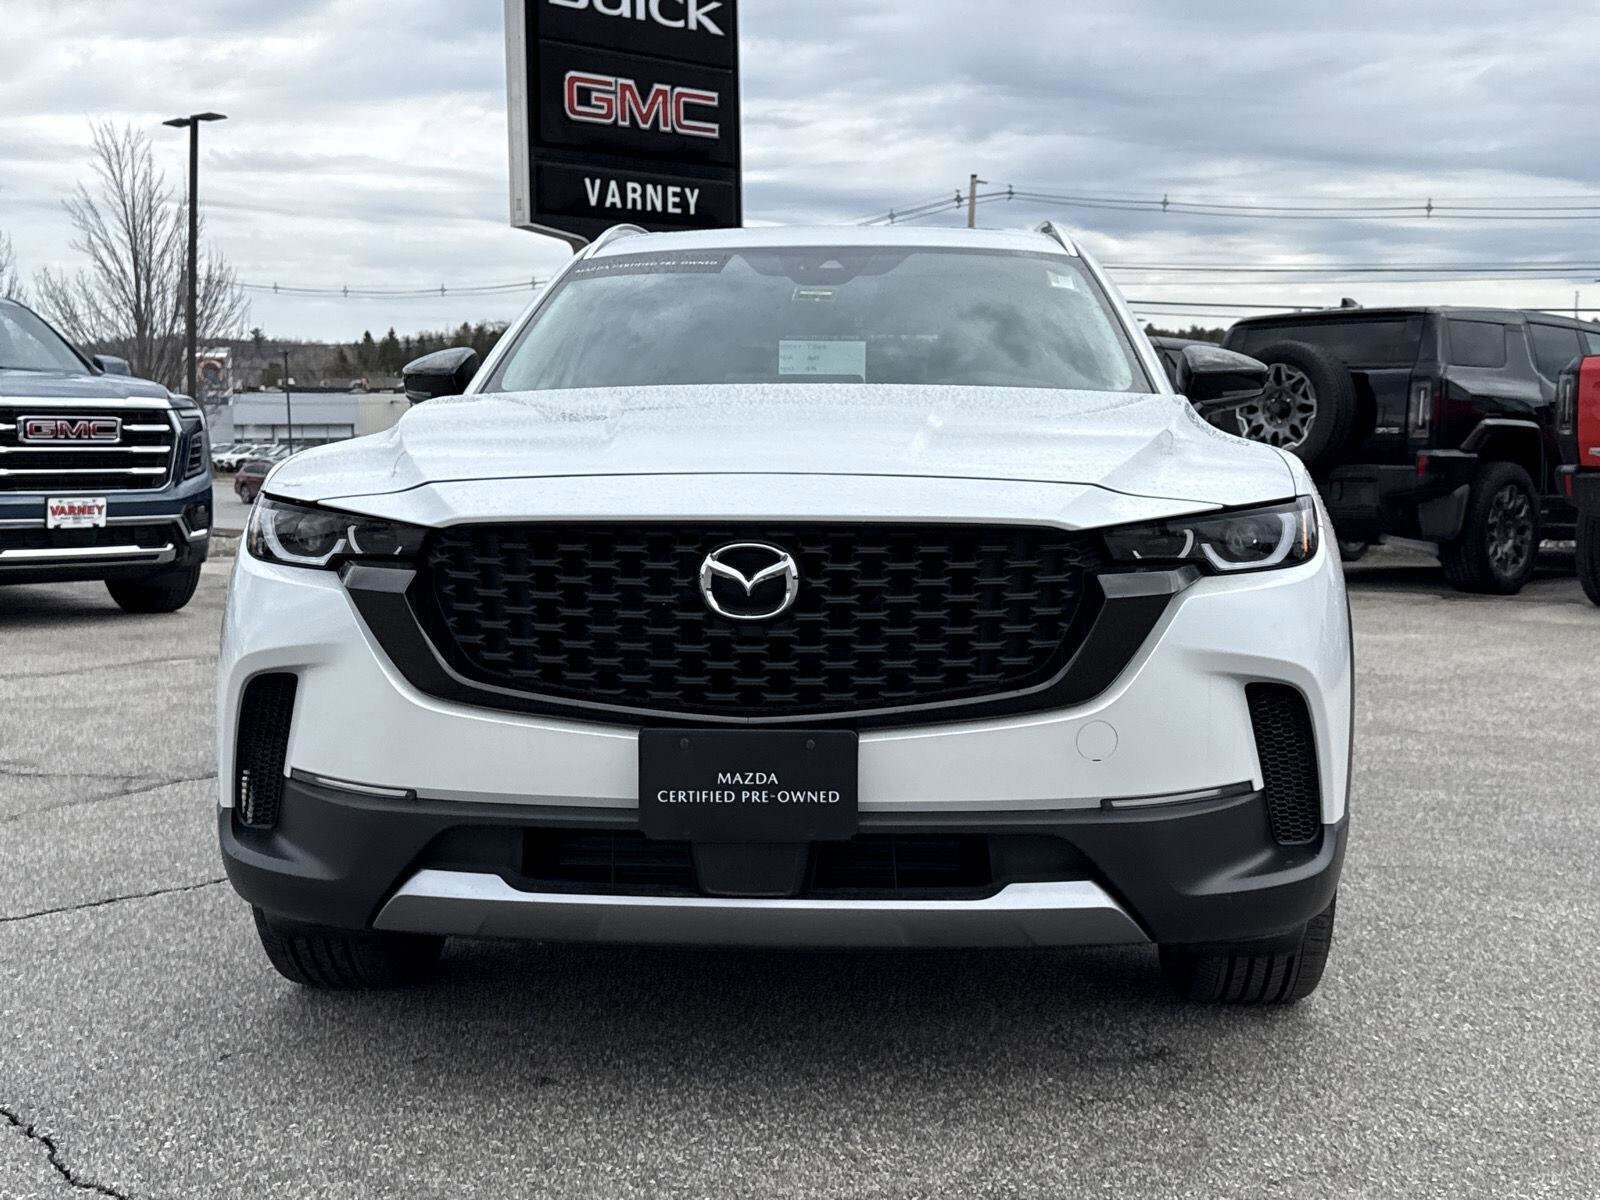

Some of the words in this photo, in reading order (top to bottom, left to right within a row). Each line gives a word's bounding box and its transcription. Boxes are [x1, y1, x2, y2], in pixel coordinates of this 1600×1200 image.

[548, 0, 725, 36] uick
[564, 71, 719, 138] GMC
[584, 177, 699, 215] VARNEY
[26, 420, 118, 439] GMC
[50, 504, 104, 516] VARNEY
[717, 772, 779, 785] MAZDA
[657, 790, 736, 803] CERTIFIED
[741, 790, 840, 803] PRE-OWNED
